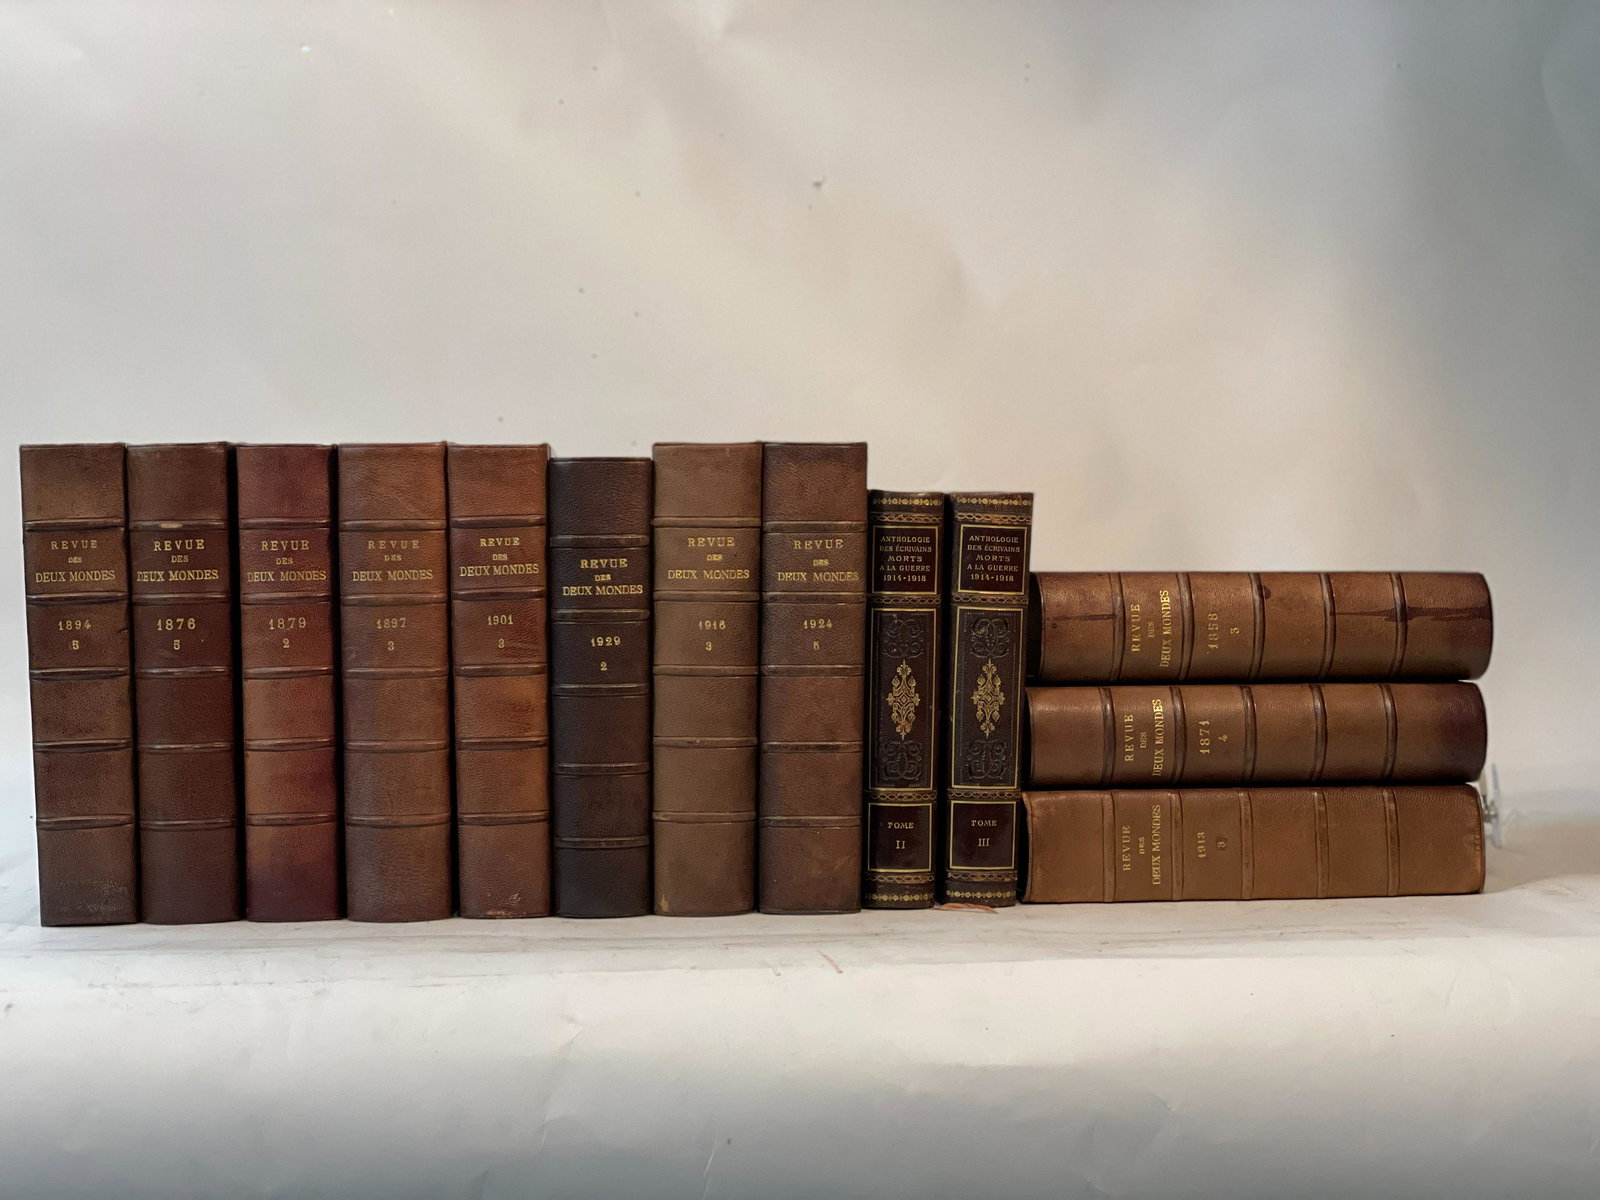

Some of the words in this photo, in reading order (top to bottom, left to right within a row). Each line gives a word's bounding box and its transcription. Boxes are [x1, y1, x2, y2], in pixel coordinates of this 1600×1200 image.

[51, 539, 98, 550] REVUE
[480, 537, 520, 547] REVUE
[688, 536, 735, 547] REVUE
[793, 539, 844, 550] REVUE
[880, 535, 931, 543] ANTHOLOGIE
[968, 535, 1019, 543] ANTHOLOGIE
[153, 539, 205, 551] REVUE
[261, 540, 310, 551] REVUE
[367, 540, 420, 550] REVUE
[895, 544, 932, 553] ÉCRIVAINS
[984, 544, 1021, 553] ÉCRIVAINS
[68, 556, 82, 564] DES
[170, 555, 189, 563] DES
[275, 557, 293, 565] DES
[384, 554, 402, 562] DES
[492, 553, 508, 561] DES
[812, 558, 829, 566] DES
[887, 555, 923, 563] MORTS
[975, 554, 1011, 562] MORTS
[580, 558, 628, 569] REVUE
[987, 564, 1019, 572] GUERRE
[136, 571, 165, 582] DEUX
[168, 569, 219, 581] MONDES
[352, 571, 382, 582] DEUX
[388, 569, 434, 581] MONDES
[459, 565, 490, 577] DEUX
[492, 563, 540, 575] MONDES
[667, 569, 698, 580] DEUX
[703, 569, 750, 580] MONDES
[35, 571, 67, 583] DEUX
[69, 570, 116, 582] MONDES
[247, 571, 275, 582] DEUX
[280, 570, 327, 581] MONDES
[594, 574, 612, 582] DES
[777, 571, 807, 581] DEUX
[813, 571, 860, 582] MONDES
[883, 574, 927, 582] 1914-1918
[970, 573, 1014, 582] 1914-1918
[562, 585, 593, 596] DEUX
[595, 584, 644, 595] MONDES
[1160, 589, 1172, 635] MONDES
[57, 620, 92, 631] 1894
[156, 618, 196, 631] 1876
[268, 617, 307, 630] 1879
[376, 617, 407, 630] 1897
[487, 614, 514, 626] 1901
[698, 620, 726, 630] 1916
[803, 618, 833, 630] 1924
[1131, 603, 1141, 652] REVUE
[1147, 621, 1155, 638] DES
[1207, 612, 1219, 650] 1858
[72, 639, 79, 650] 5
[173, 639, 181, 650] 5
[282, 638, 290, 649] 2
[387, 640, 395, 651] 3
[498, 638, 505, 649] 3
[590, 636, 621, 647] 1929
[705, 641, 713, 651] 3
[1160, 638, 1172, 668] DEUX
[600, 661, 608, 671] 2
[1152, 698, 1165, 745] MONDES
[1124, 714, 1135, 762] REVUE
[1139, 731, 1147, 749] DES
[1199, 719, 1211, 755] 1871
[1218, 734, 1228, 742] 4
[1152, 749, 1164, 777] DEUX
[970, 819, 998, 827] TOME
[1151, 804, 1161, 852] MONDES
[895, 840, 906, 849] II
[977, 838, 990, 847] III
[1122, 825, 1131, 871] REVUE
[1151, 855, 1161, 885] DEUX
